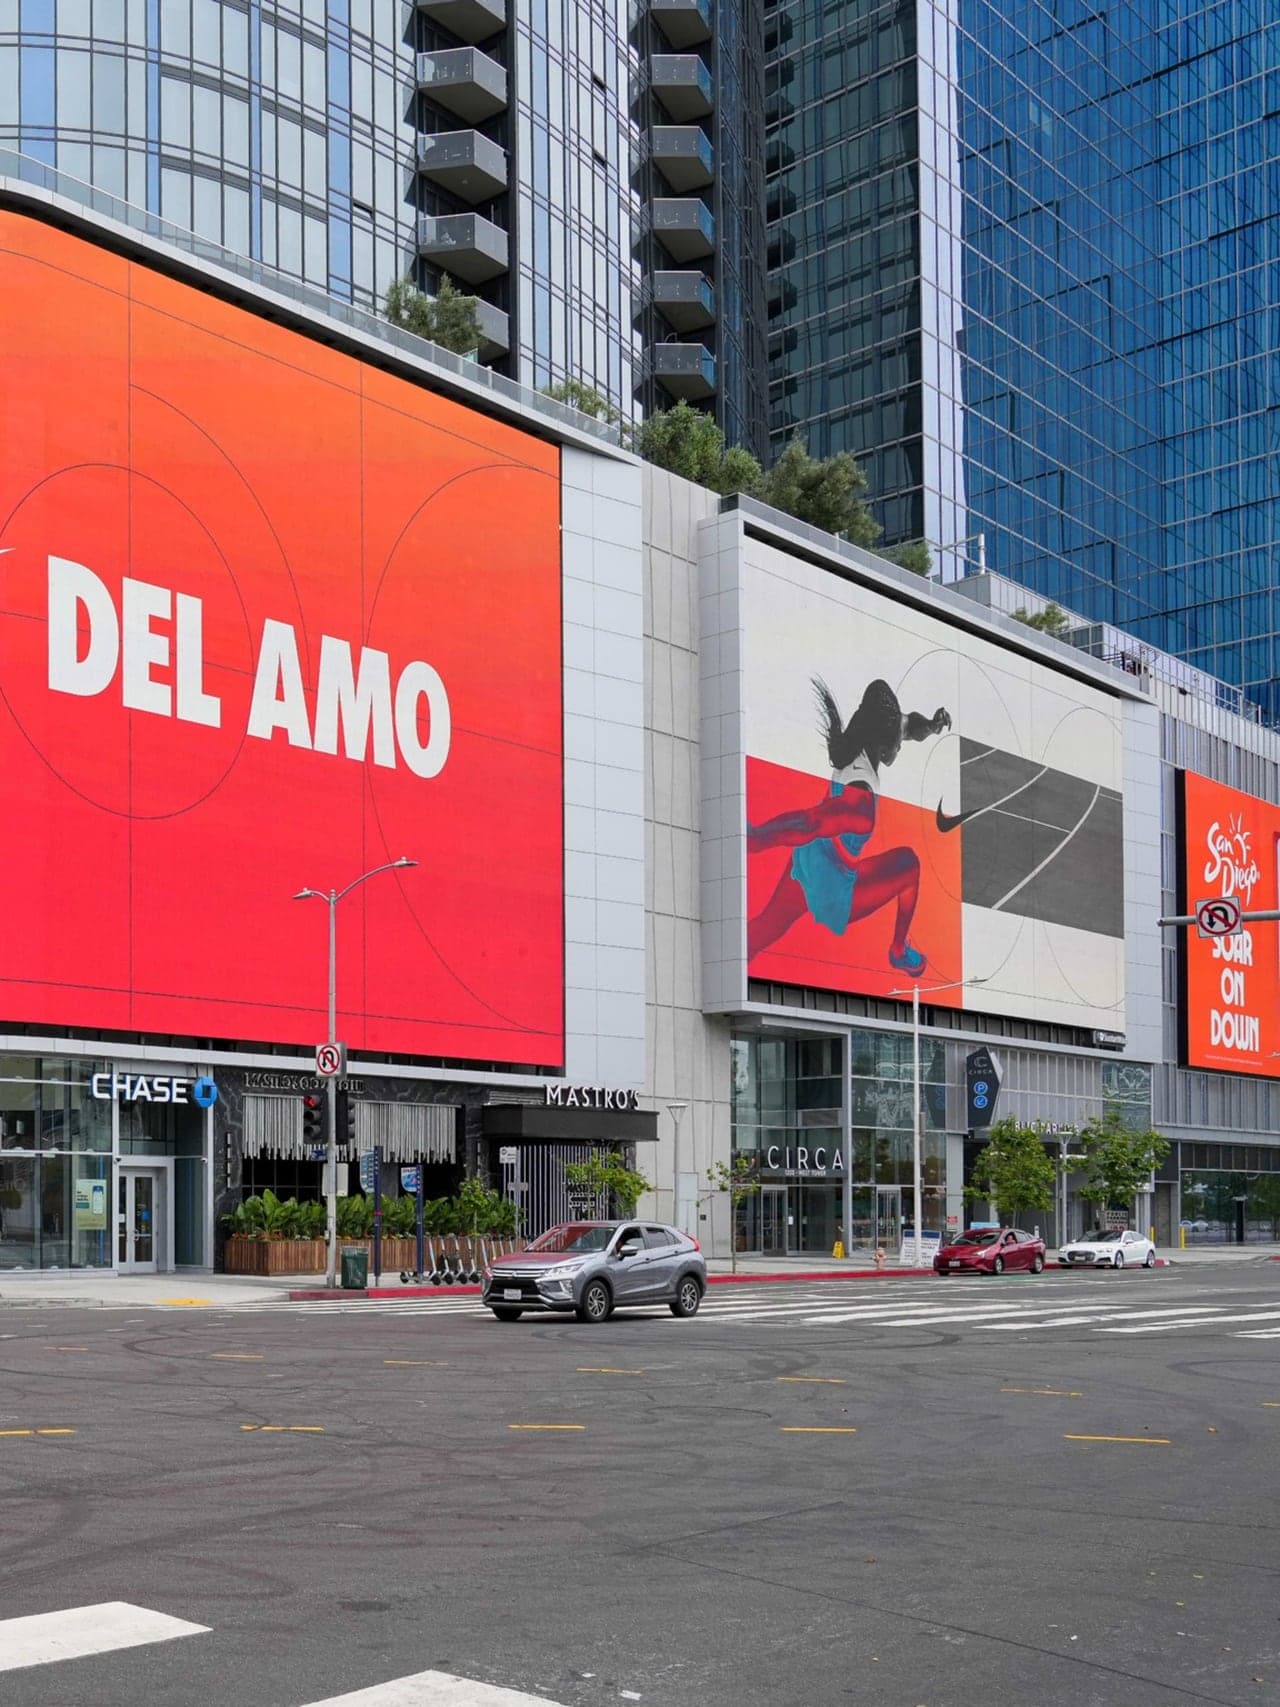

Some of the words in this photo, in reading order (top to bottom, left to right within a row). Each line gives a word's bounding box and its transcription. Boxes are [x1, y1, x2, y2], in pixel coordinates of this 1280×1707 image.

[48, 554, 220, 728] DEL
[246, 617, 451, 778] AMO
[1204, 822, 1234, 883] San
[1221, 857, 1258, 906] Diego
[1212, 930, 1253, 966] SOAR
[1220, 967, 1245, 1007] ON
[1210, 1009, 1259, 1052] DOWN
[92, 1073, 189, 1104] CHASE
[545, 1084, 640, 1110] MASTRO'S
[767, 1145, 844, 1170] CIRCA
